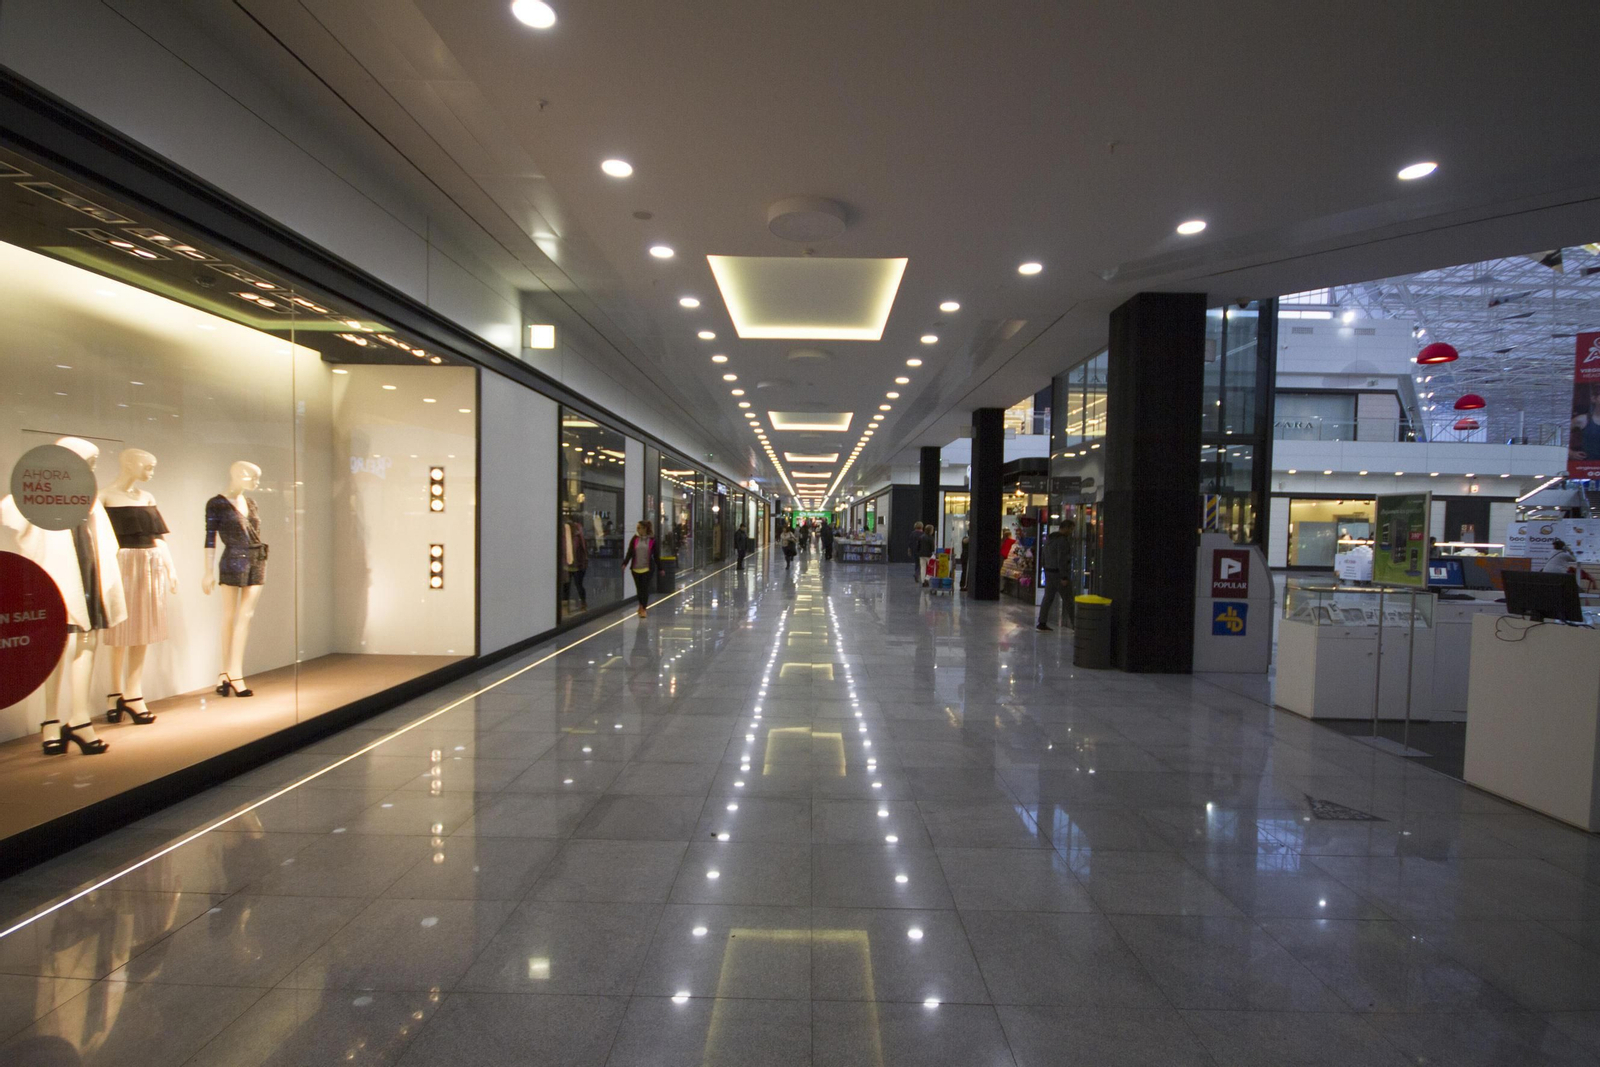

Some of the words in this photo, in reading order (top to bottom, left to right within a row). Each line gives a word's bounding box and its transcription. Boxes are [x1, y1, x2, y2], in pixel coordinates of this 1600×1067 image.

[1274, 421, 1313, 429] ZARA
[22, 469, 72, 481] AHORA
[22, 479, 52, 493] MÁS
[23, 494, 91, 505] MODELOS!
[1213, 581, 1247, 589] POPULAR
[13, 609, 47, 622] SALE
[0, 635, 30, 649] NTO
